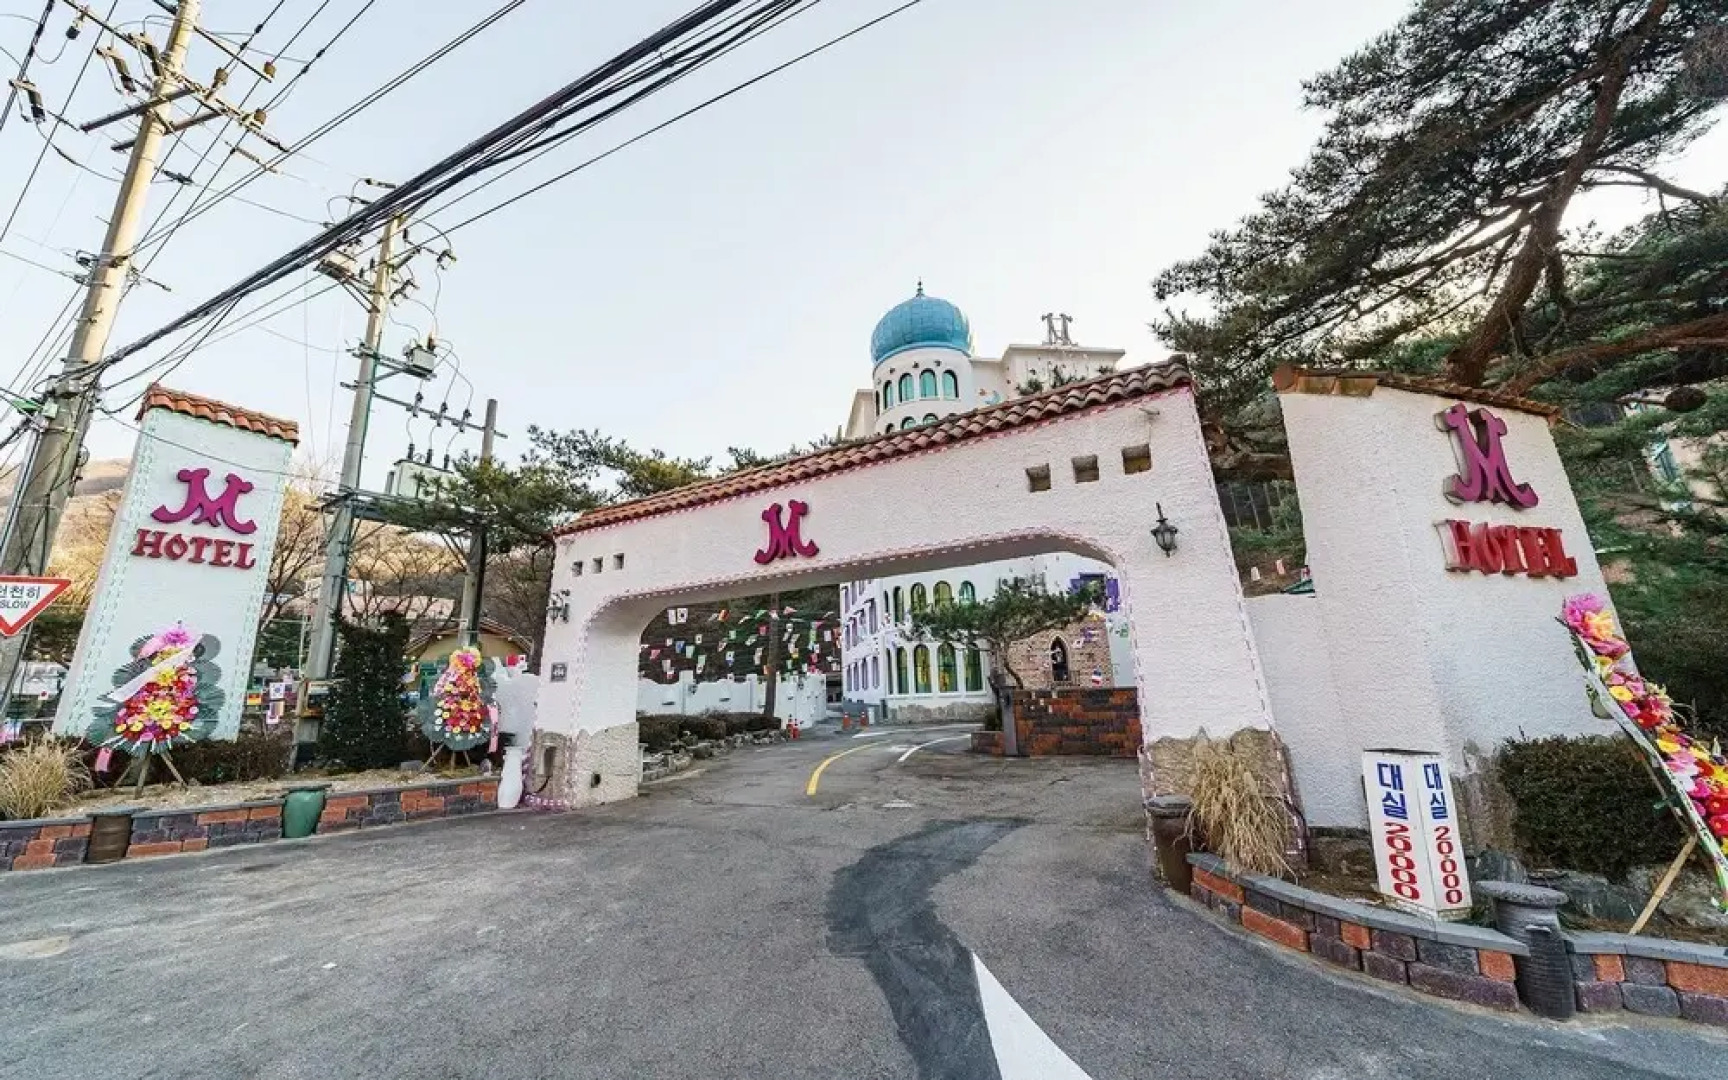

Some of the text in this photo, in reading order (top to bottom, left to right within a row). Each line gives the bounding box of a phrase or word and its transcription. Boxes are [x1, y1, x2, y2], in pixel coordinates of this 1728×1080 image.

[1434, 402, 1539, 509] M
[150, 467, 258, 535] M
[753, 499, 819, 565] M
[130, 528, 256, 570] HOTEL
[1433, 519, 1578, 581] HOTEL
[1377, 763, 1408, 819] 대실
[1423, 763, 1448, 819] 대실
